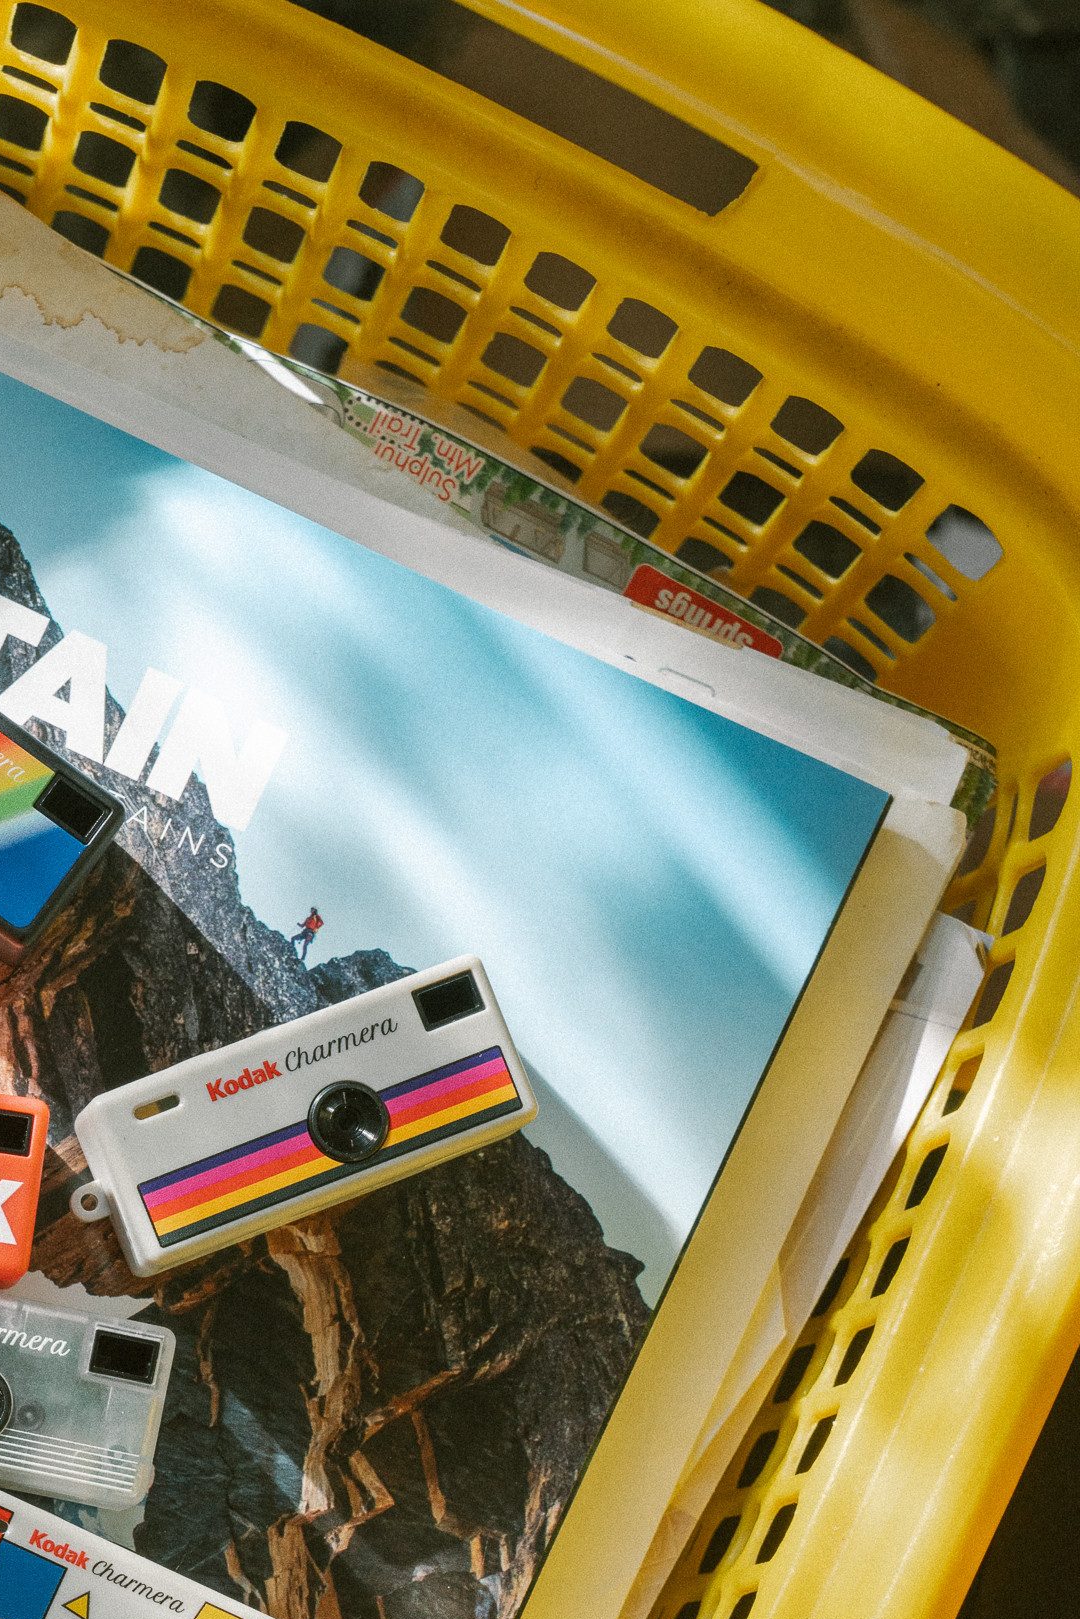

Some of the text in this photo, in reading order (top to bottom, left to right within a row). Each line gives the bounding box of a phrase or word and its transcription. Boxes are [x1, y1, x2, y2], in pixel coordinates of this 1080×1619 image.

[370, 409, 484, 484] Mtn. Trail
[205, 1015, 399, 1102] Kodak Charmera
[28, 1529, 187, 1613] Kodak Charmera
